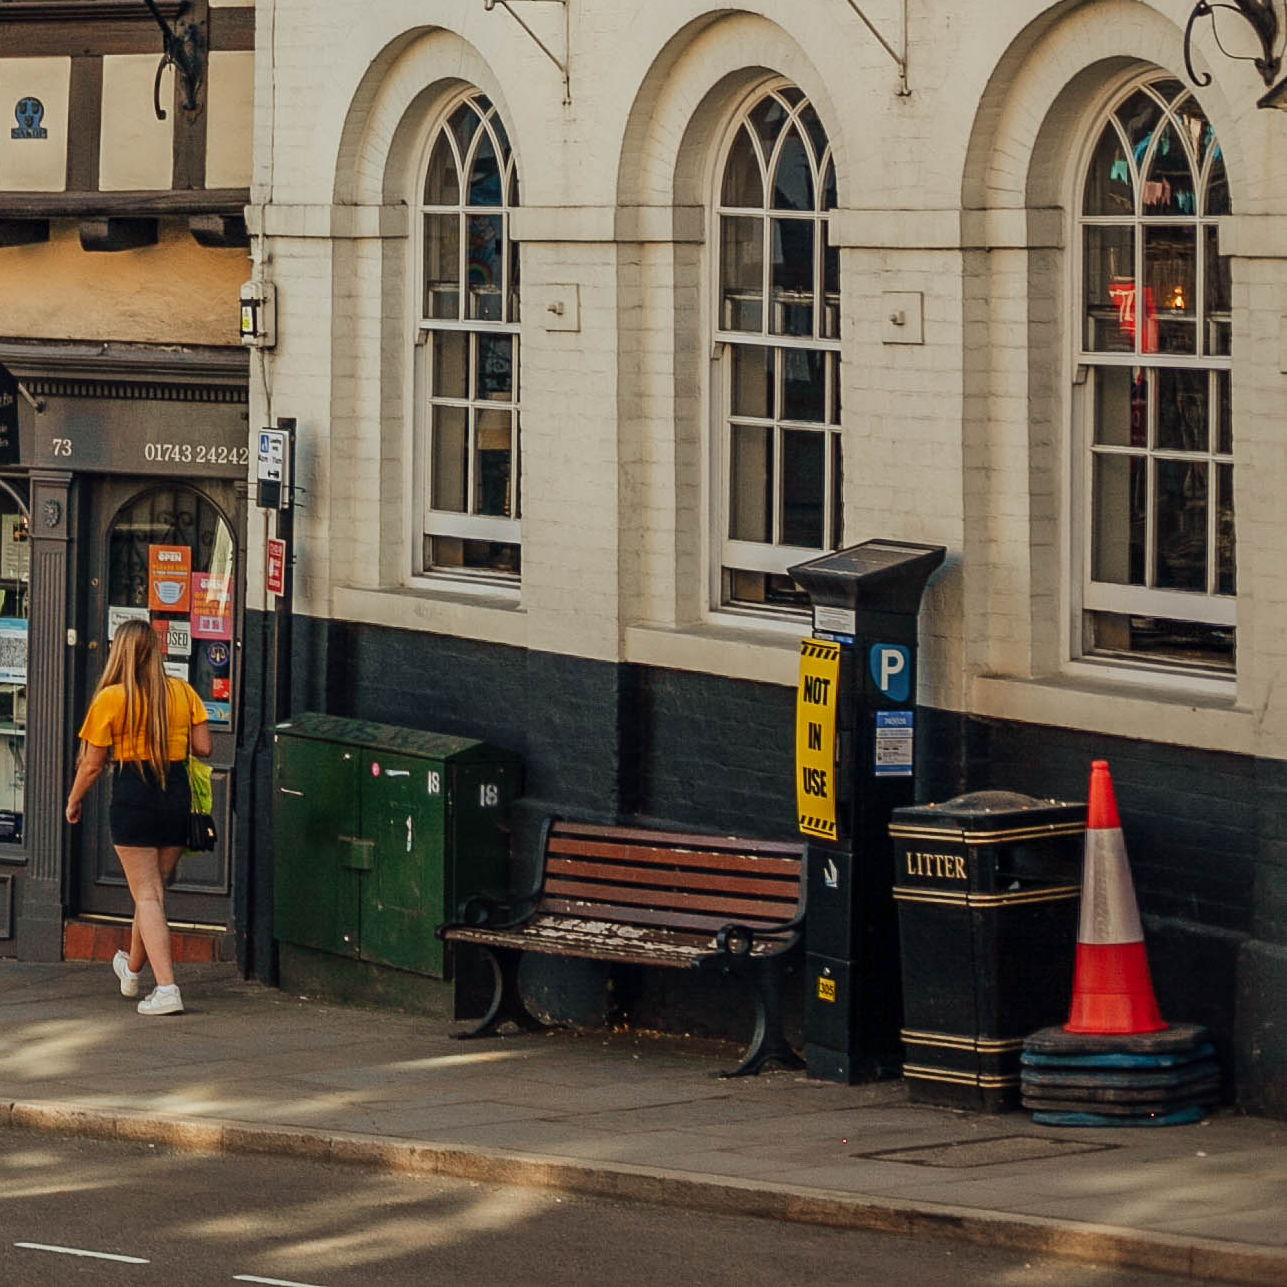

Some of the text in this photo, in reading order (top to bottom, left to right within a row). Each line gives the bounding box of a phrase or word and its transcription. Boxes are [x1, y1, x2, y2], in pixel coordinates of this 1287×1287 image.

[52, 439, 73, 457] 73
[144, 443, 192, 463] 01743
[881, 649, 905, 691] P
[803, 674, 831, 706] NOT
[808, 721, 822, 751] IN
[428, 770, 440, 795] 18
[802, 766, 828, 799] USE
[906, 851, 967, 880] LITTER
